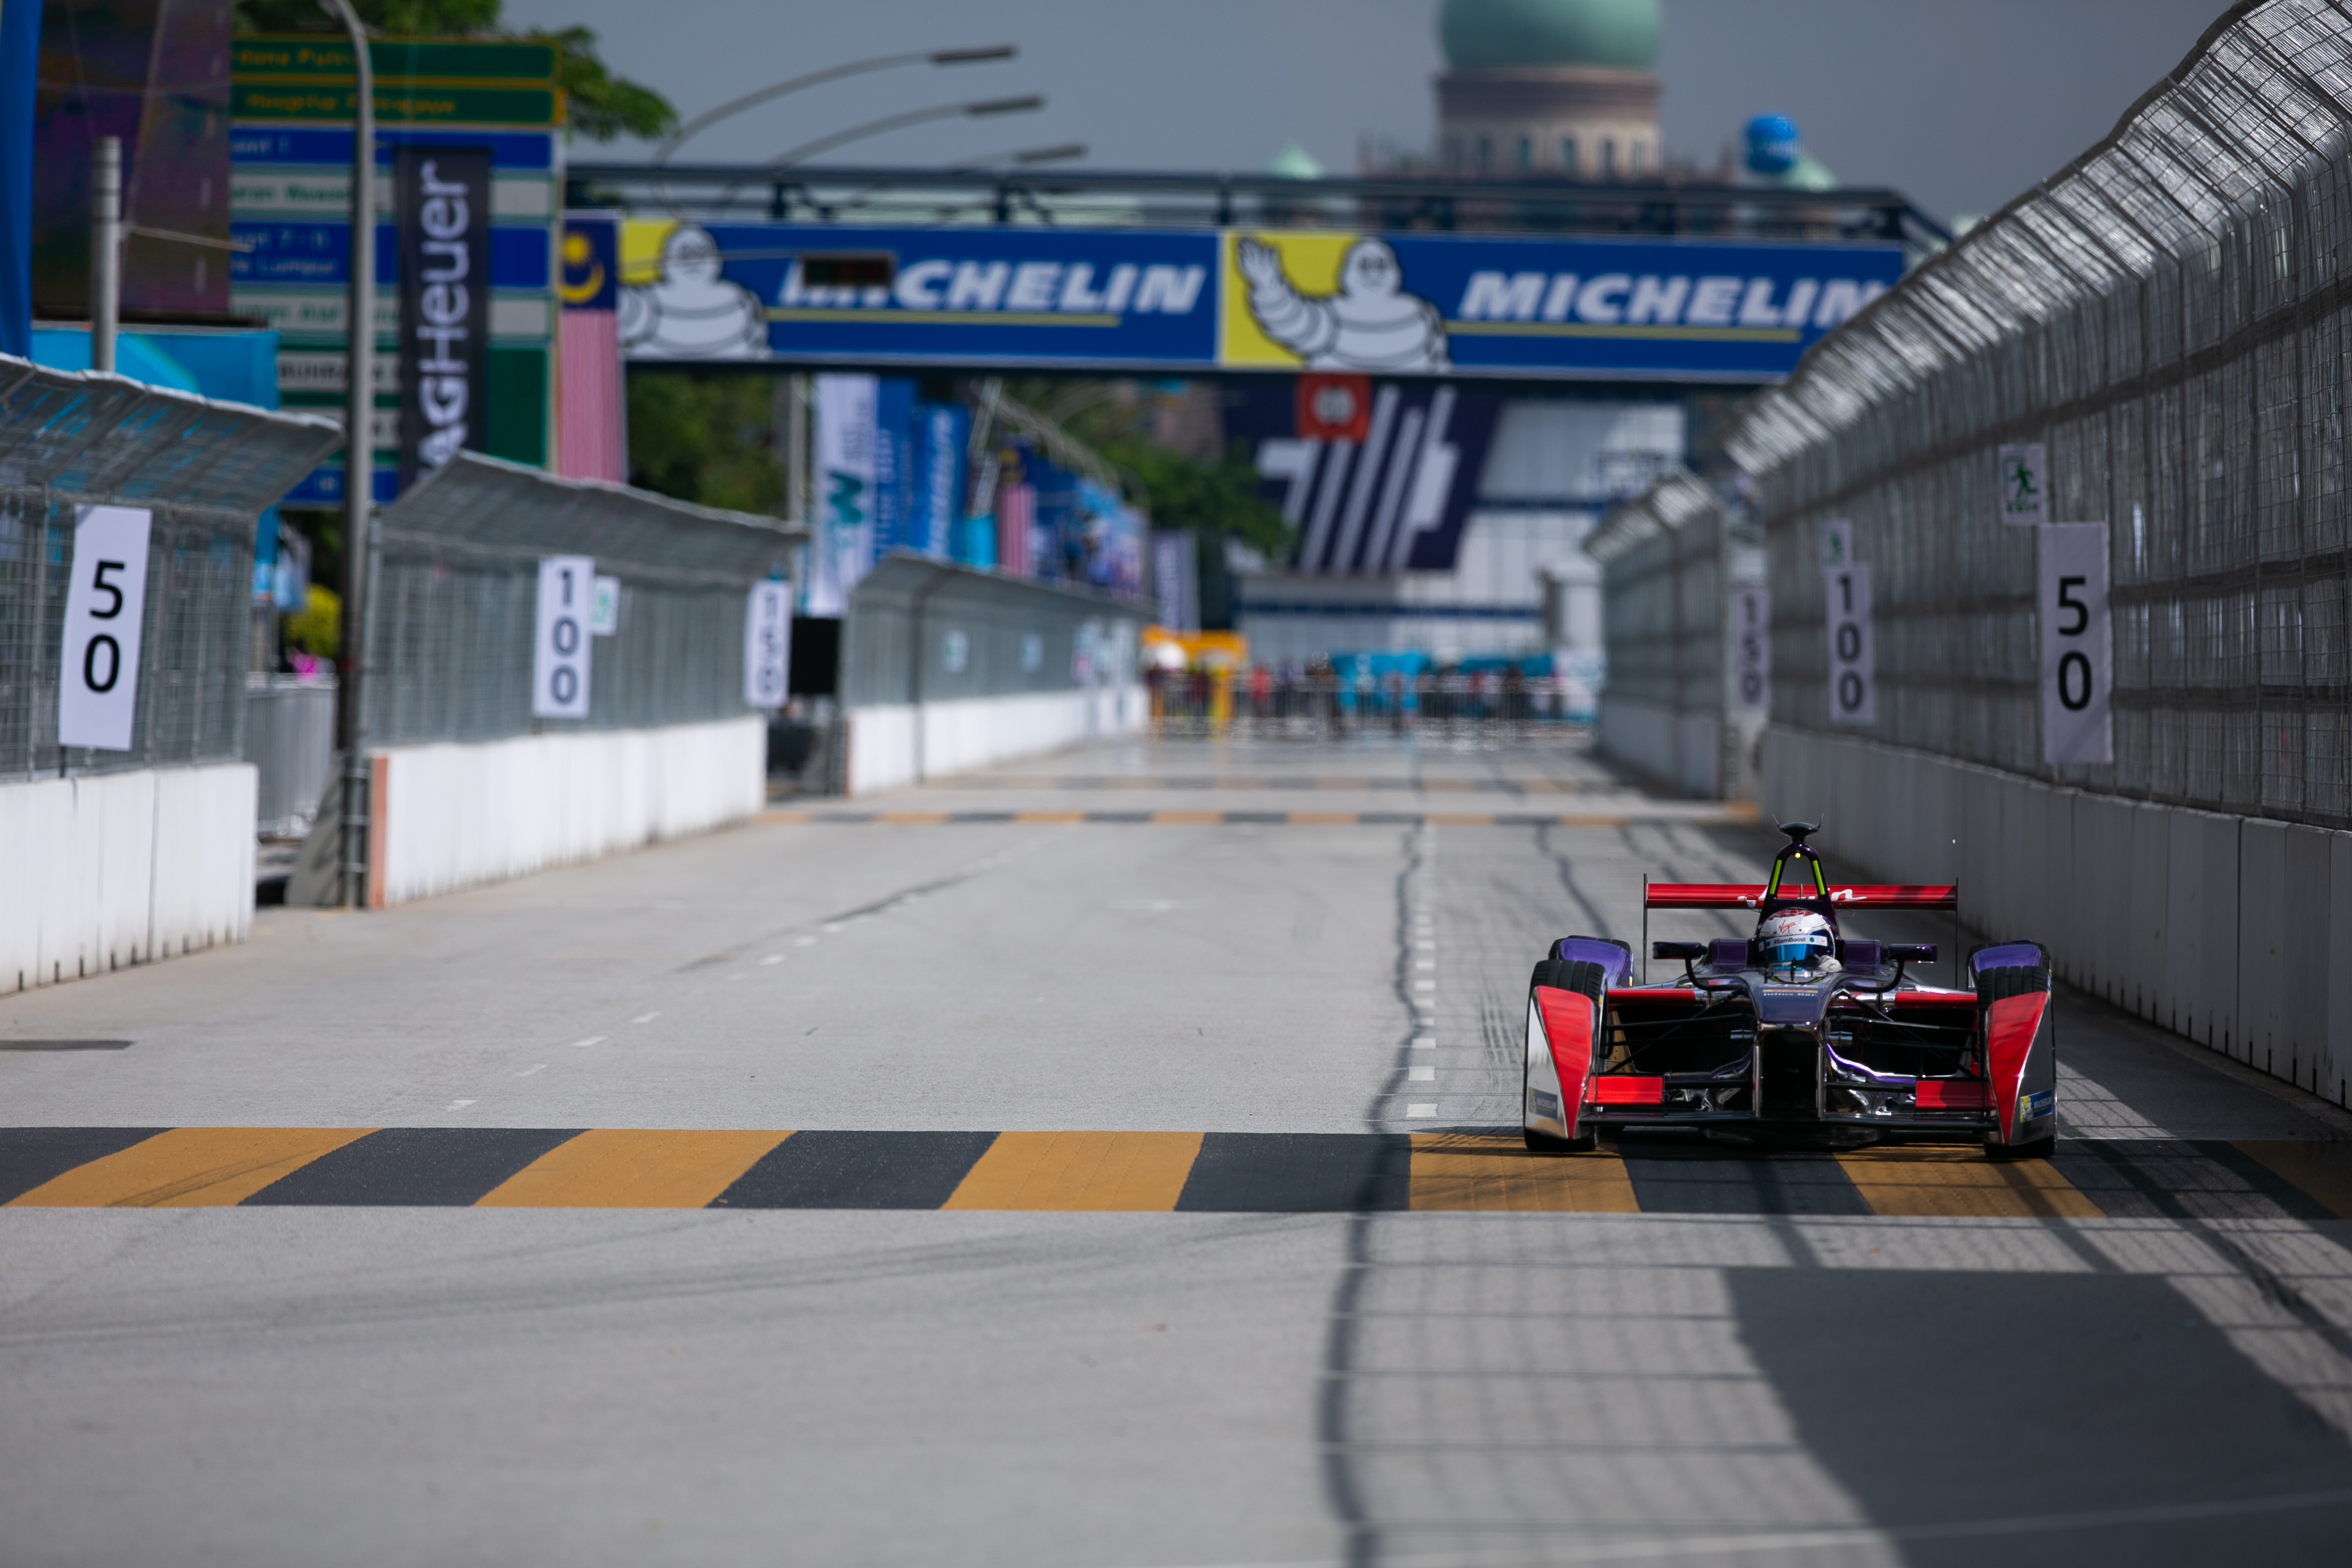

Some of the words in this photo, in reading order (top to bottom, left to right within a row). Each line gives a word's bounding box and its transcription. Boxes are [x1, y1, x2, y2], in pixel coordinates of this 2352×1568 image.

[417, 159, 469, 468] AGHeuer
[83, 559, 126, 694] 50
[551, 568, 580, 706] 100
[1836, 574, 1865, 712] 100
[2057, 576, 2092, 711] 50
[1774, 937, 1807, 945] #SamBoost
[1778, 919, 1797, 934] Virgin
